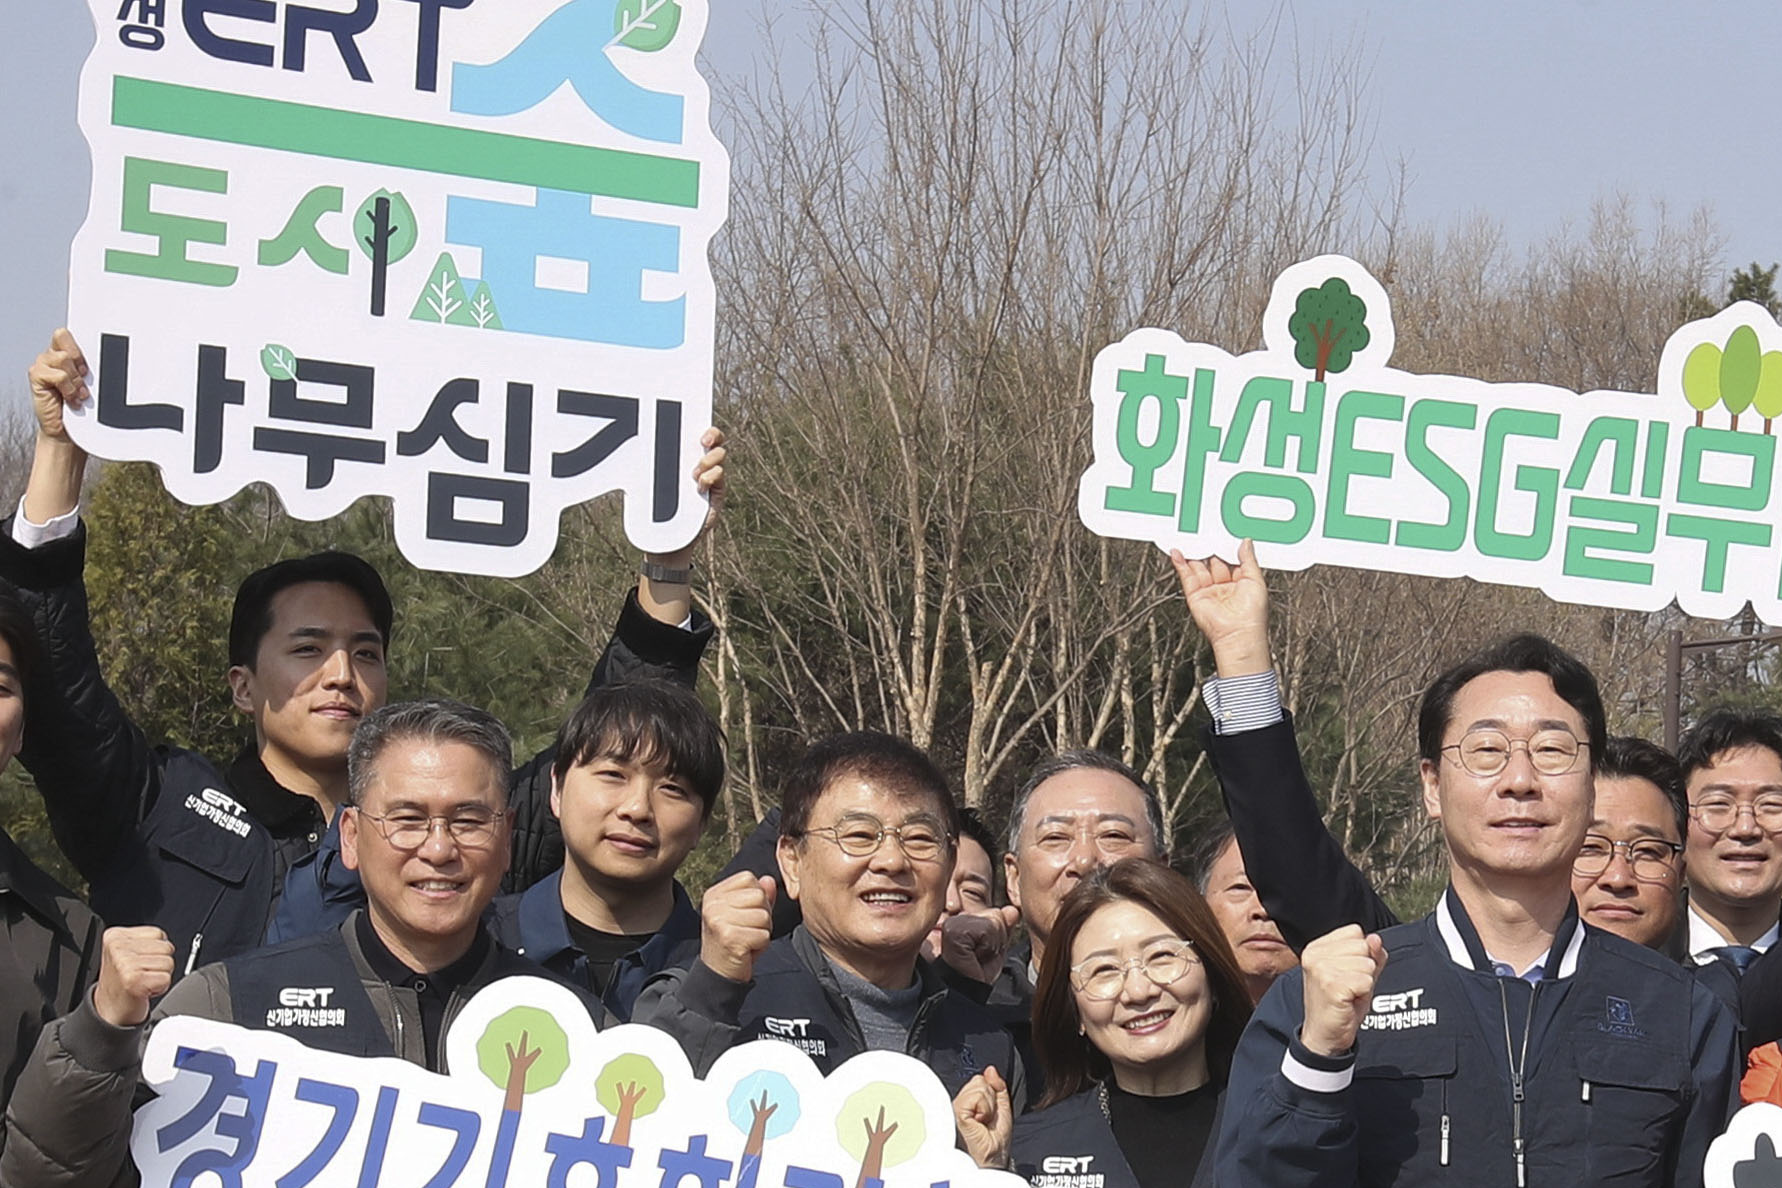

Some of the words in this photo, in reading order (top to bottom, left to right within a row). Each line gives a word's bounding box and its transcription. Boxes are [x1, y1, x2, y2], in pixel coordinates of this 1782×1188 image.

[97, 333, 684, 548] 나무심기
[202, 787, 248, 817] ERT
[279, 986, 335, 1008] ERT
[1372, 987, 1424, 1013] ERT
[764, 1015, 811, 1037] ERT
[1042, 1154, 1095, 1174] ERT
